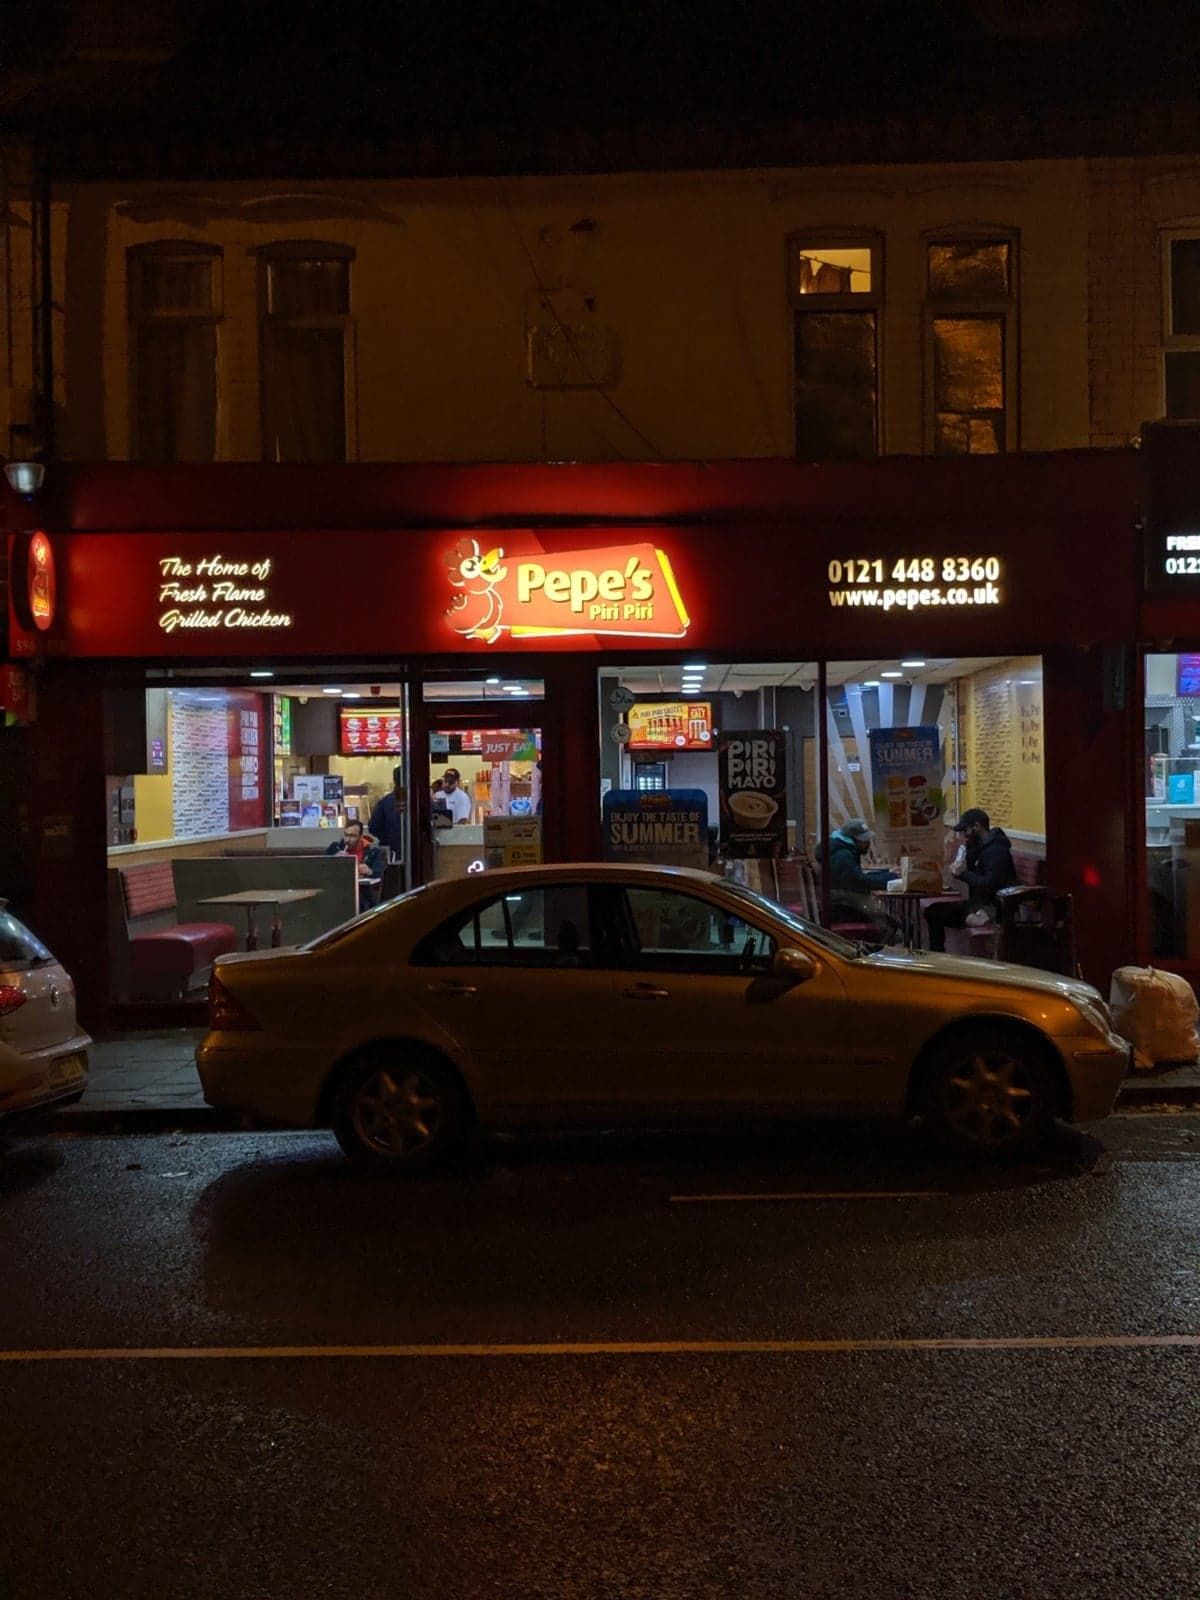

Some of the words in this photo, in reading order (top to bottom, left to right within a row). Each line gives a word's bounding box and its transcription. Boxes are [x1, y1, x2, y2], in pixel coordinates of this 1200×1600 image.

[159, 557, 192, 577] The
[196, 554, 248, 576] Home
[251, 558, 271, 580] of
[828, 559, 883, 583] 0121
[891, 558, 935, 582] 448
[941, 557, 1000, 582] 8360
[159, 582, 208, 602] Fresh
[212, 581, 265, 602] Flame
[517, 556, 654, 613] Pepe's
[828, 582, 1000, 611] www.pepes.co.uk
[159, 609, 223, 633] Grilled
[224, 607, 291, 628] Chicken
[589, 604, 619, 621] Piri
[623, 603, 653, 620] Piri
[486, 743, 510, 753] JUST
[512, 742, 532, 752] EAT
[727, 740, 776, 758] PIRI
[727, 758, 776, 777] PIRI
[727, 775, 777, 789] MAYO
[610, 822, 699, 845] SUMMER
